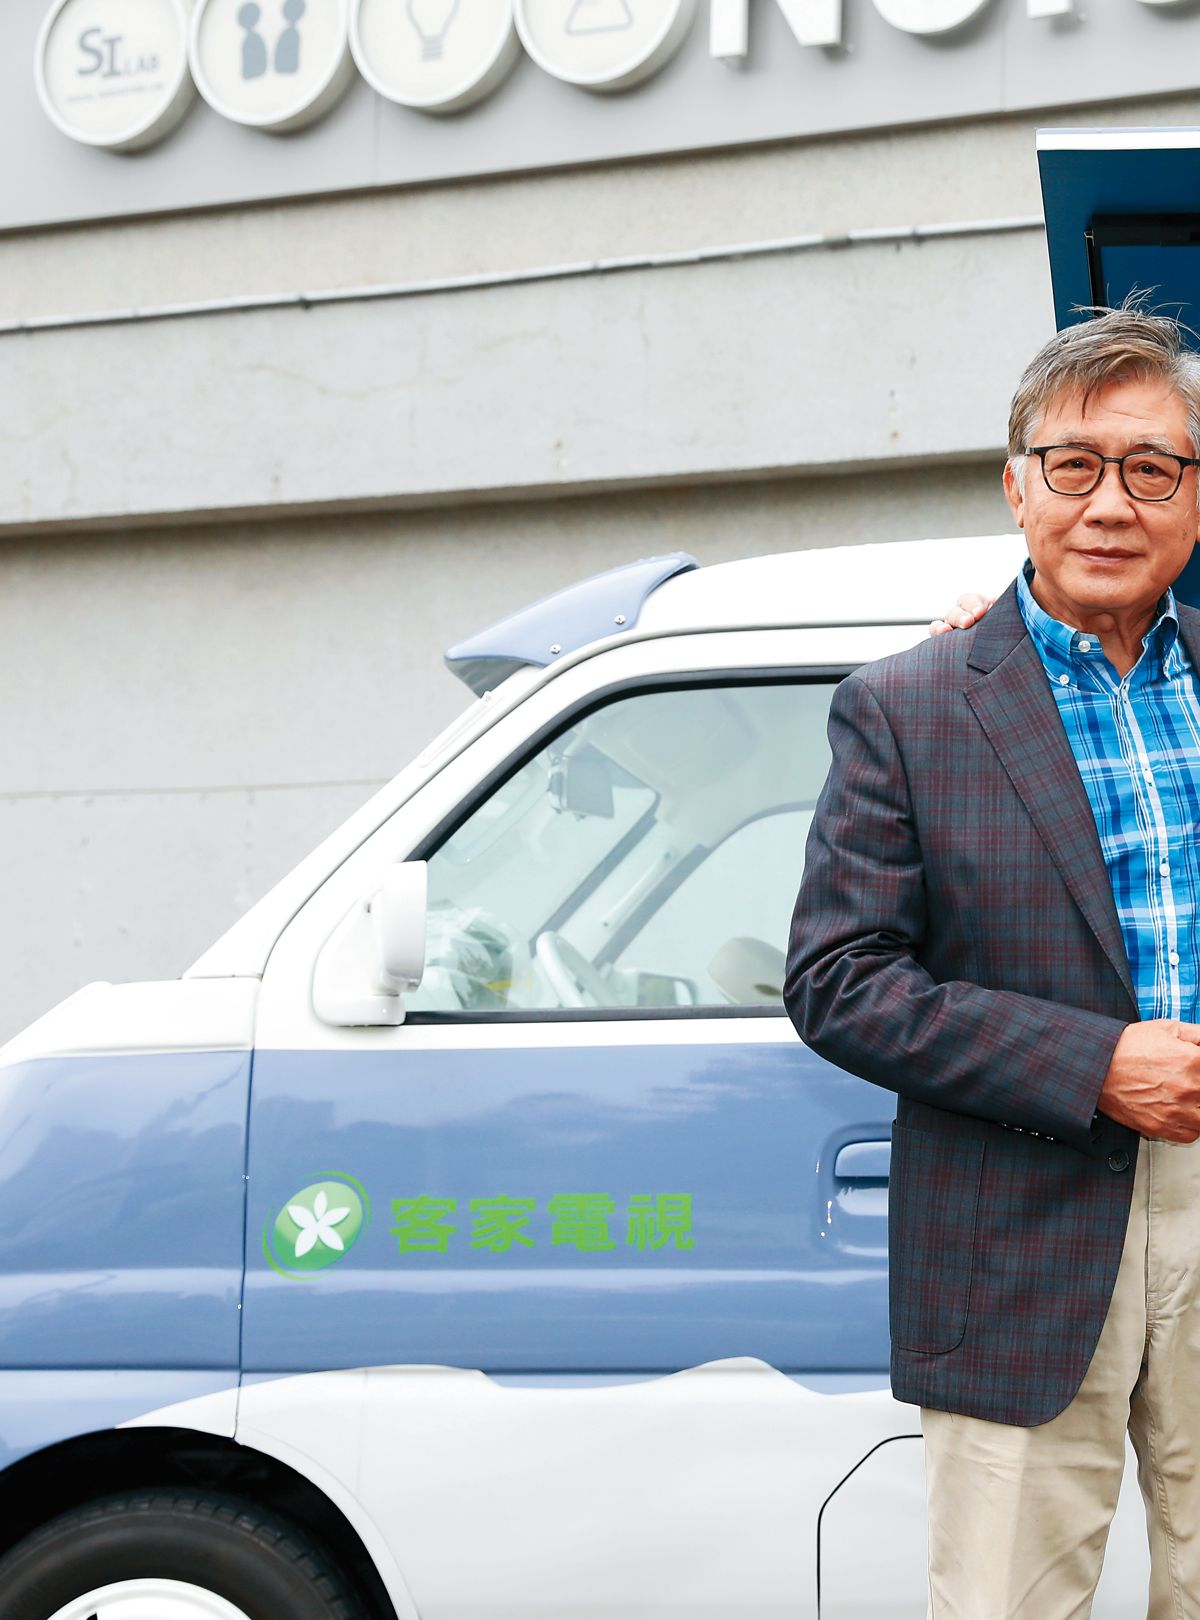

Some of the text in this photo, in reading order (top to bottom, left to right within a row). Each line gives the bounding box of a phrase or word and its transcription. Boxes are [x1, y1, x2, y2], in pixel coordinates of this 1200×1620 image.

[75, 26, 123, 78] SI
[390, 1192, 696, 1255] 客家電視
